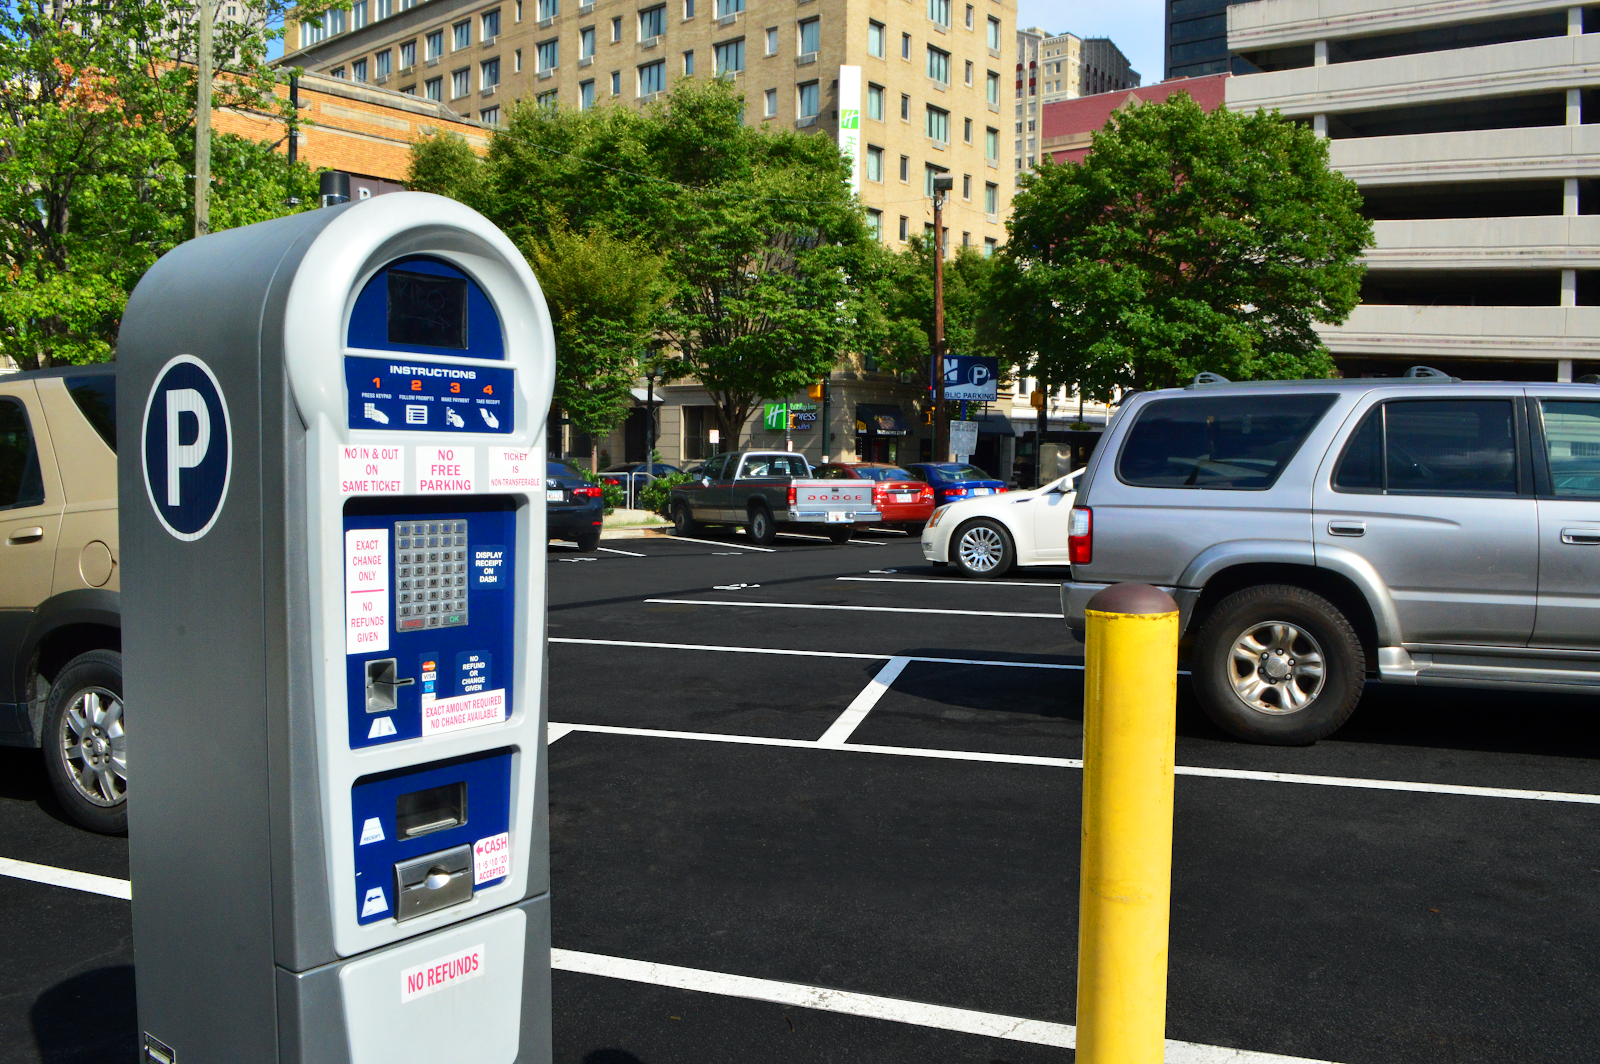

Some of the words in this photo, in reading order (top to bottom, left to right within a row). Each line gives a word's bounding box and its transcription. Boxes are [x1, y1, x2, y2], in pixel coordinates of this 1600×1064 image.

[390, 365, 477, 380] INSTRUCTIONS
[973, 366, 987, 384] P
[372, 377, 381, 388] 1
[411, 380, 422, 391] 2
[450, 382, 461, 393] 3
[483, 384, 493, 395] 4
[166, 388, 211, 507] P
[344, 448, 357, 459] NO
[360, 448, 369, 459] IN
[372, 448, 379, 460] &
[381, 449, 399, 460] OUT
[438, 449, 454, 461] NO
[503, 452, 528, 461] TICKET
[365, 464, 378, 475] ON
[431, 465, 461, 476] FREE
[512, 466, 519, 474] IS
[342, 480, 369, 492] SAME
[370, 480, 401, 492] TICKET
[420, 479, 472, 491] PARKING
[490, 478, 540, 487] NON-TRANSFERABLE
[356, 540, 379, 550] EXACT
[352, 555, 382, 566] CHANGE
[475, 551, 503, 559] DISPLAY
[475, 559, 503, 567] RECEIPT
[358, 571, 377, 581] ONLY
[479, 575, 498, 583] DASH
[362, 602, 373, 612] NO
[351, 616, 385, 629] REFUNDS
[402, 619, 424, 628] CANCEL
[449, 615, 459, 623] OK
[357, 632, 379, 643] GIVEN
[462, 662, 486, 670] REFUND
[461, 677, 486, 685] CHANGE
[464, 684, 482, 693] GIVEN
[425, 705, 445, 718] EXACT
[445, 701, 472, 714] AMOUNT
[472, 695, 502, 710] REQUIRED
[430, 718, 440, 730] NO
[441, 713, 466, 728] CHANGE
[467, 708, 498, 722] AVAILABLE
[484, 836, 507, 855] CASH
[478, 865, 506, 882] ACCEPTED
[408, 971, 424, 994] NO
[427, 953, 479, 987] REFUNDS
